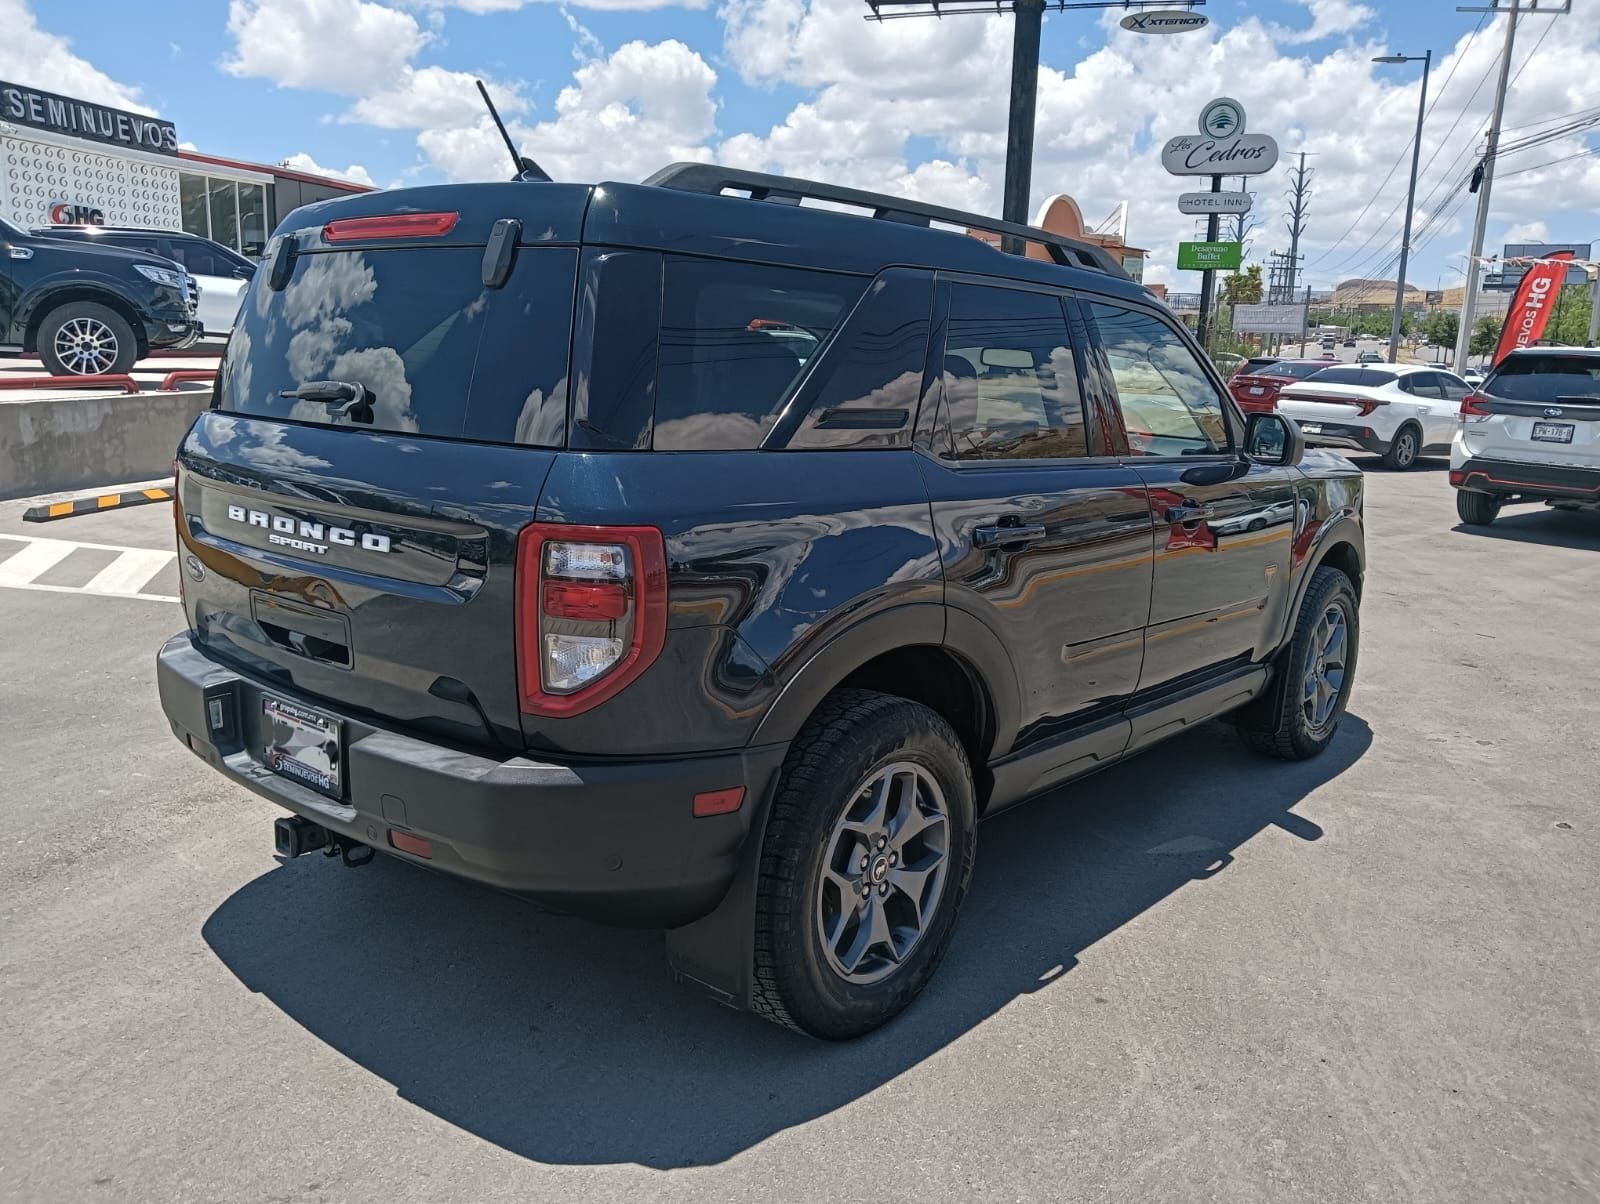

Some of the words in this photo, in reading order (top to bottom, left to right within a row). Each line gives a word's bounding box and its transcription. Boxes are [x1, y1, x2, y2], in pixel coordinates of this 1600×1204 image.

[6, 88, 177, 150] SEMINUEVOS
[1170, 138, 1192, 154] Los
[1185, 139, 1266, 169] Cedros
[74, 205, 105, 226] HG
[1191, 244, 1229, 253] Desayuno
[1197, 252, 1220, 260] Buffet
[1525, 277, 1552, 308] HG
[228, 504, 390, 553] BRONCO
[268, 534, 329, 554] SPORT
